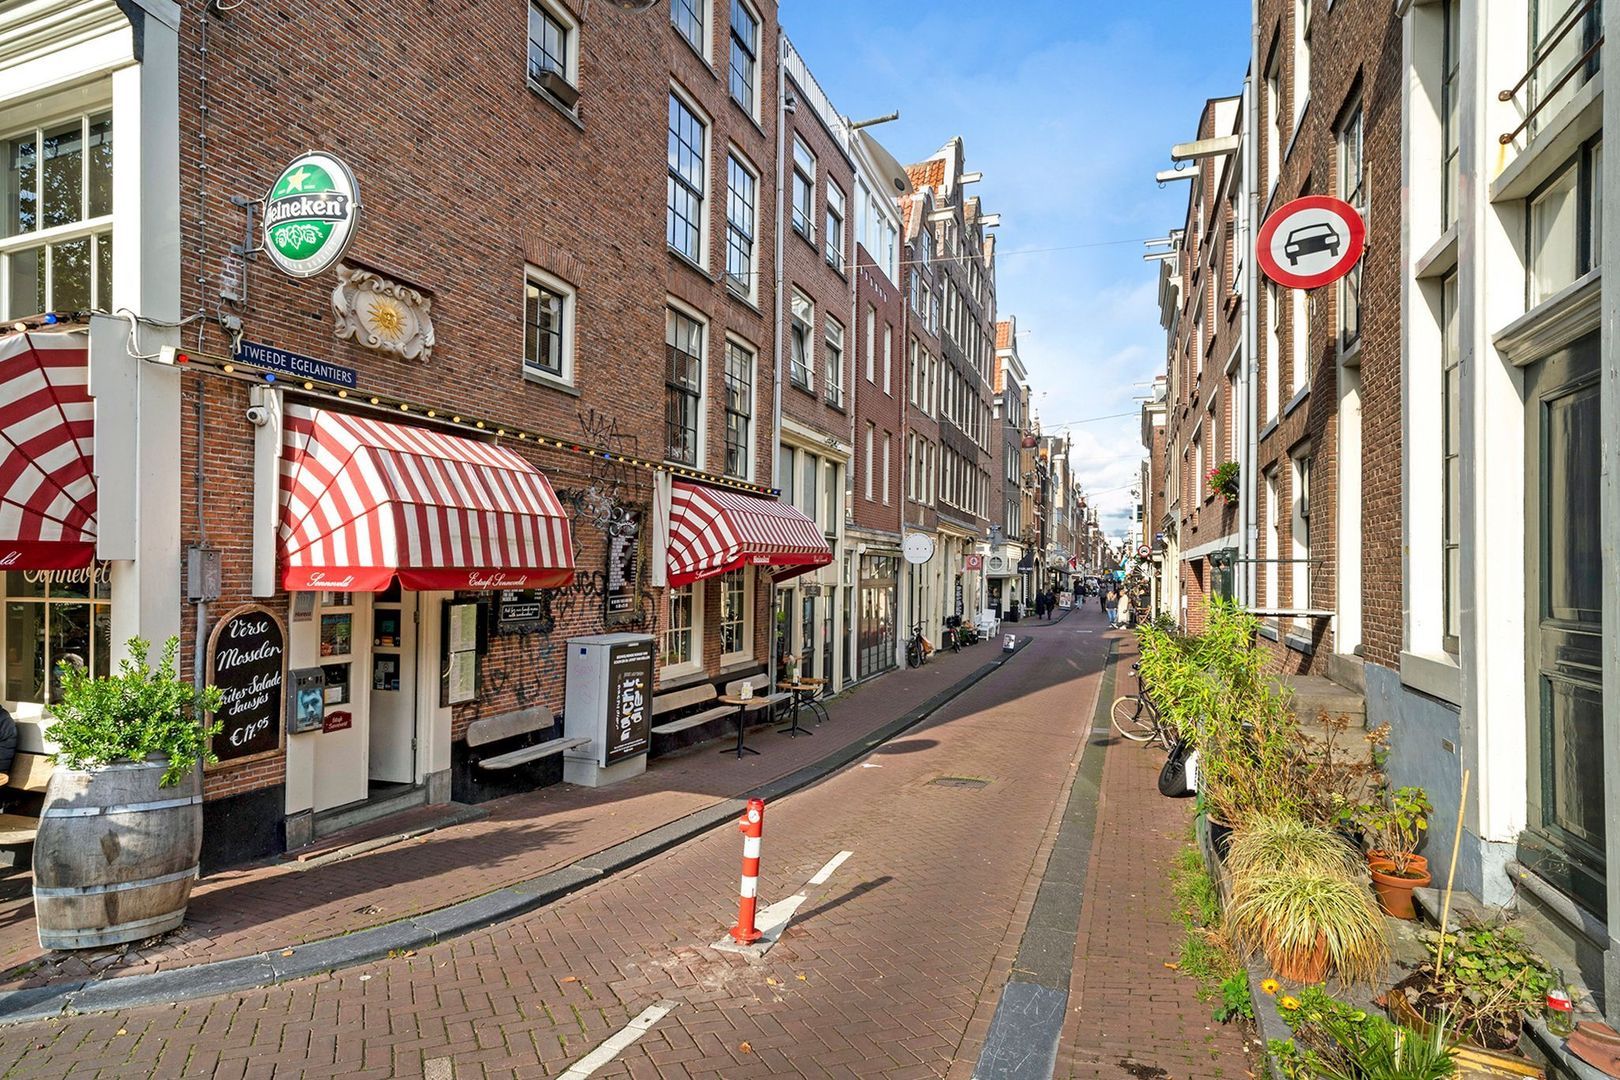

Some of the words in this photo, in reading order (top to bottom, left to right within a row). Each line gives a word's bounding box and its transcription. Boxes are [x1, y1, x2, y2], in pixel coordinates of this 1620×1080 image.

[243, 344, 287, 367] TWEEDE
[291, 357, 352, 383] EGELANTIERS
[228, 619, 269, 639] Verse
[216, 640, 282, 672] Mosselen
